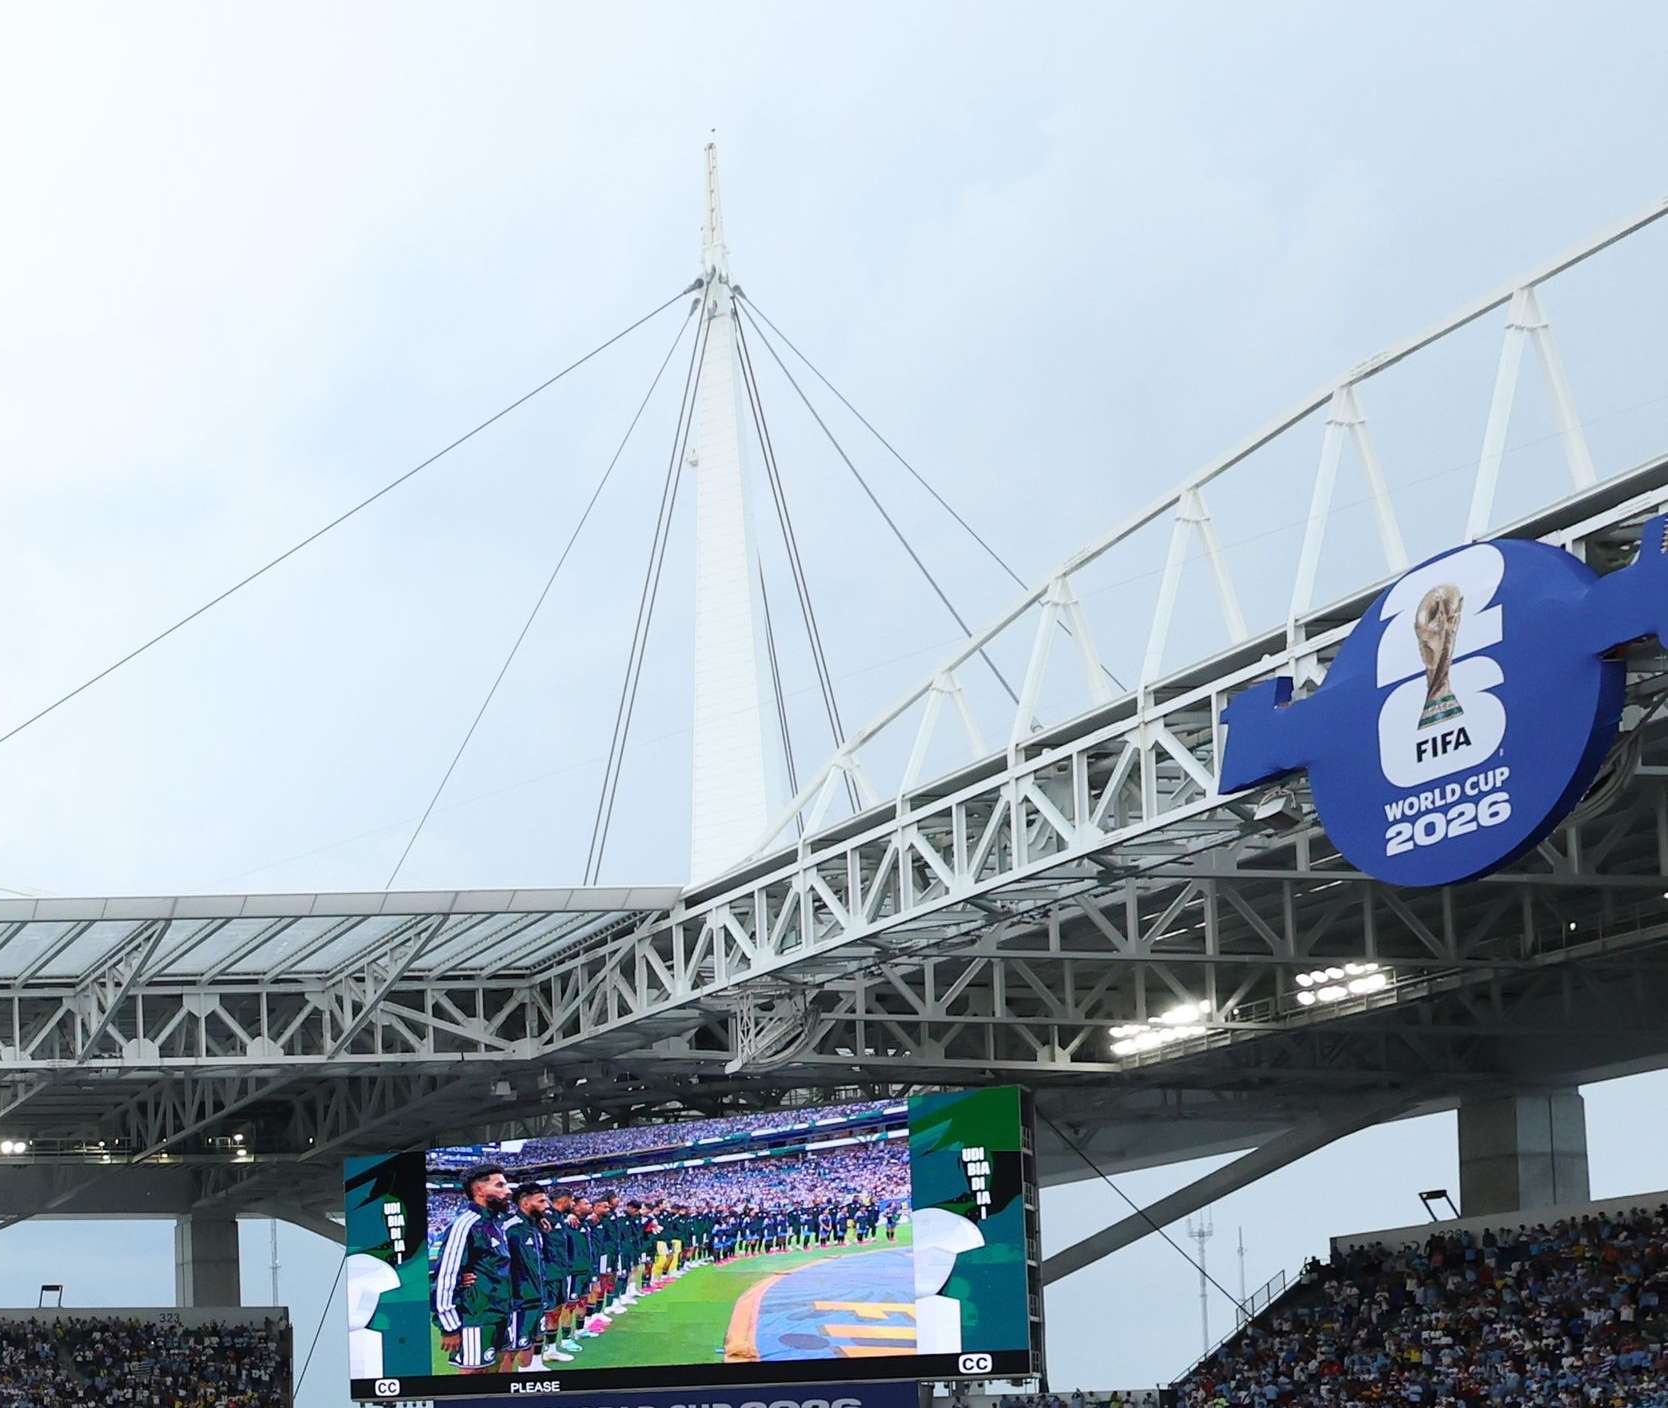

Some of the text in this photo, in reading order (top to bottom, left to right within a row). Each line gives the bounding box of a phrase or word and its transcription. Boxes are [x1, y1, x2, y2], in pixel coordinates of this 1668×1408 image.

[1416, 727, 1471, 764] FIFA
[1385, 767, 1511, 821] WORLD CUP
[1386, 793, 1512, 857] 2026
[160, 1313, 180, 1324] 323
[965, 1357, 988, 1370] CC
[378, 1382, 397, 1393] CC
[510, 1380, 560, 1393] PLEASE
